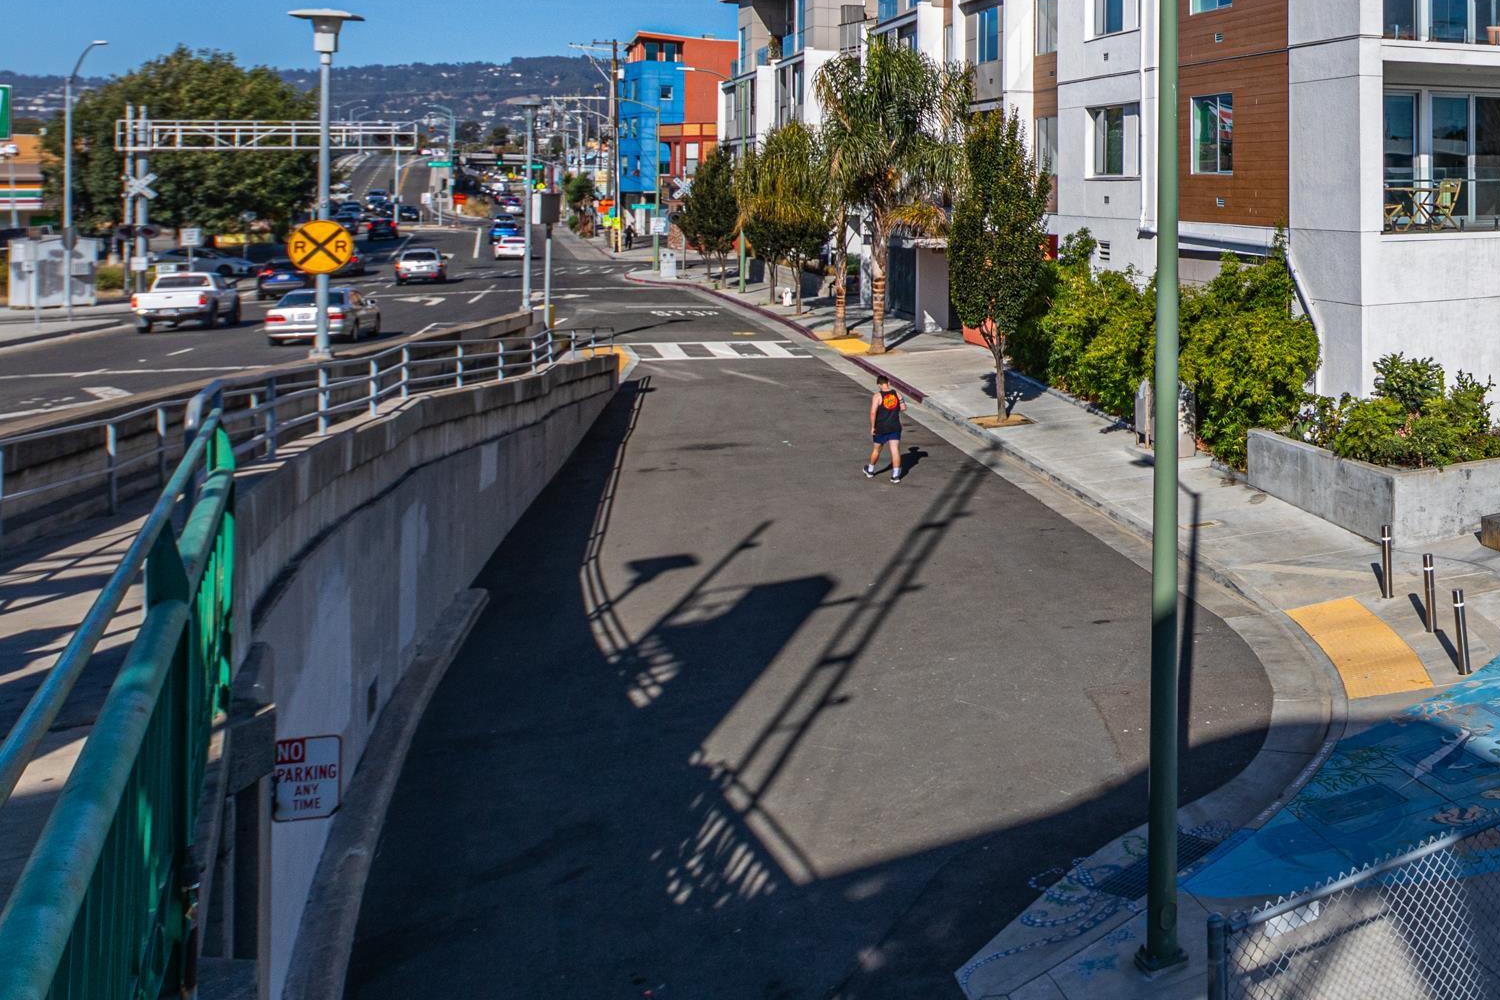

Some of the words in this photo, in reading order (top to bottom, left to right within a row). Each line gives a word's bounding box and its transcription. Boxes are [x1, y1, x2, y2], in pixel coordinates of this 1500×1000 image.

[294, 241, 306, 253] R
[335, 240, 347, 253] R
[277, 742, 303, 762] NO
[276, 764, 336, 783] PARKING
[294, 784, 319, 797] ANY
[293, 797, 321, 811] TIME
